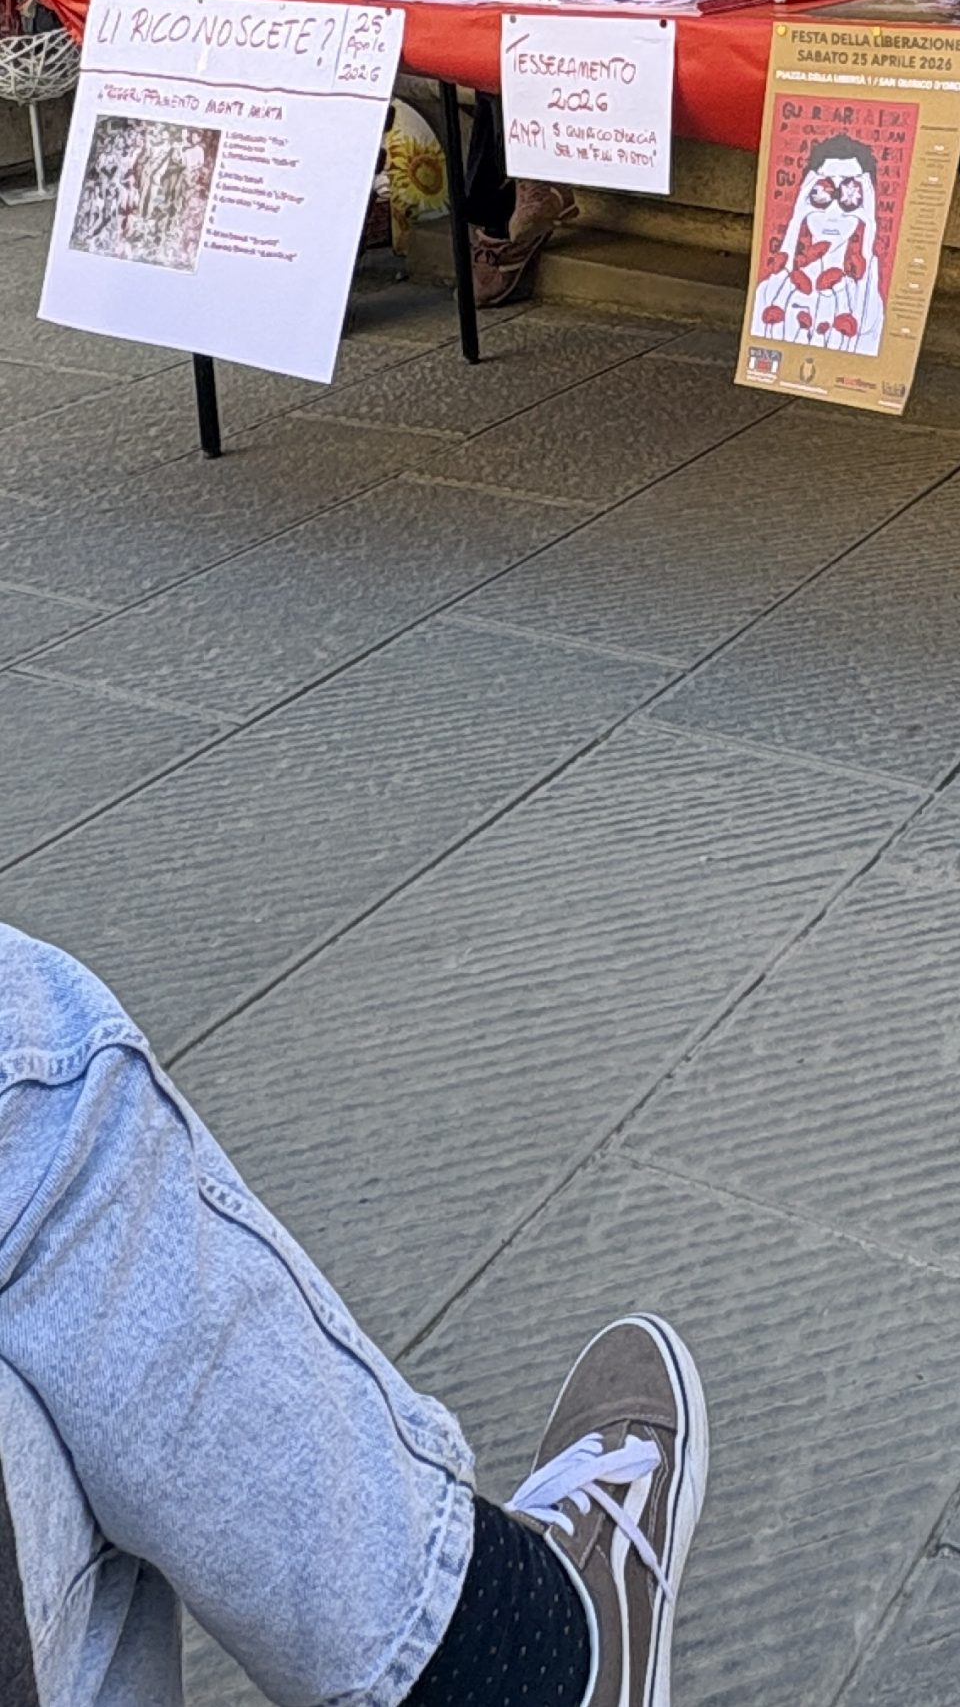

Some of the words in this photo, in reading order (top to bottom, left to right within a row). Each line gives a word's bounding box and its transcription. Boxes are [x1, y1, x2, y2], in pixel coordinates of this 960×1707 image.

[97, 7, 121, 43] LI
[791, 30, 829, 45] FESTA
[831, 32, 871, 48] DELLA
[506, 33, 637, 84] TESSERAMENTO
[797, 49, 849, 66] SABATO
[852, 52, 868, 67] 25
[871, 55, 916, 70] APRILE
[919, 57, 953, 72] 2026
[338, 64, 382, 82] 2026
[548, 87, 608, 112] 2026
[508, 119, 546, 150] ANPI
